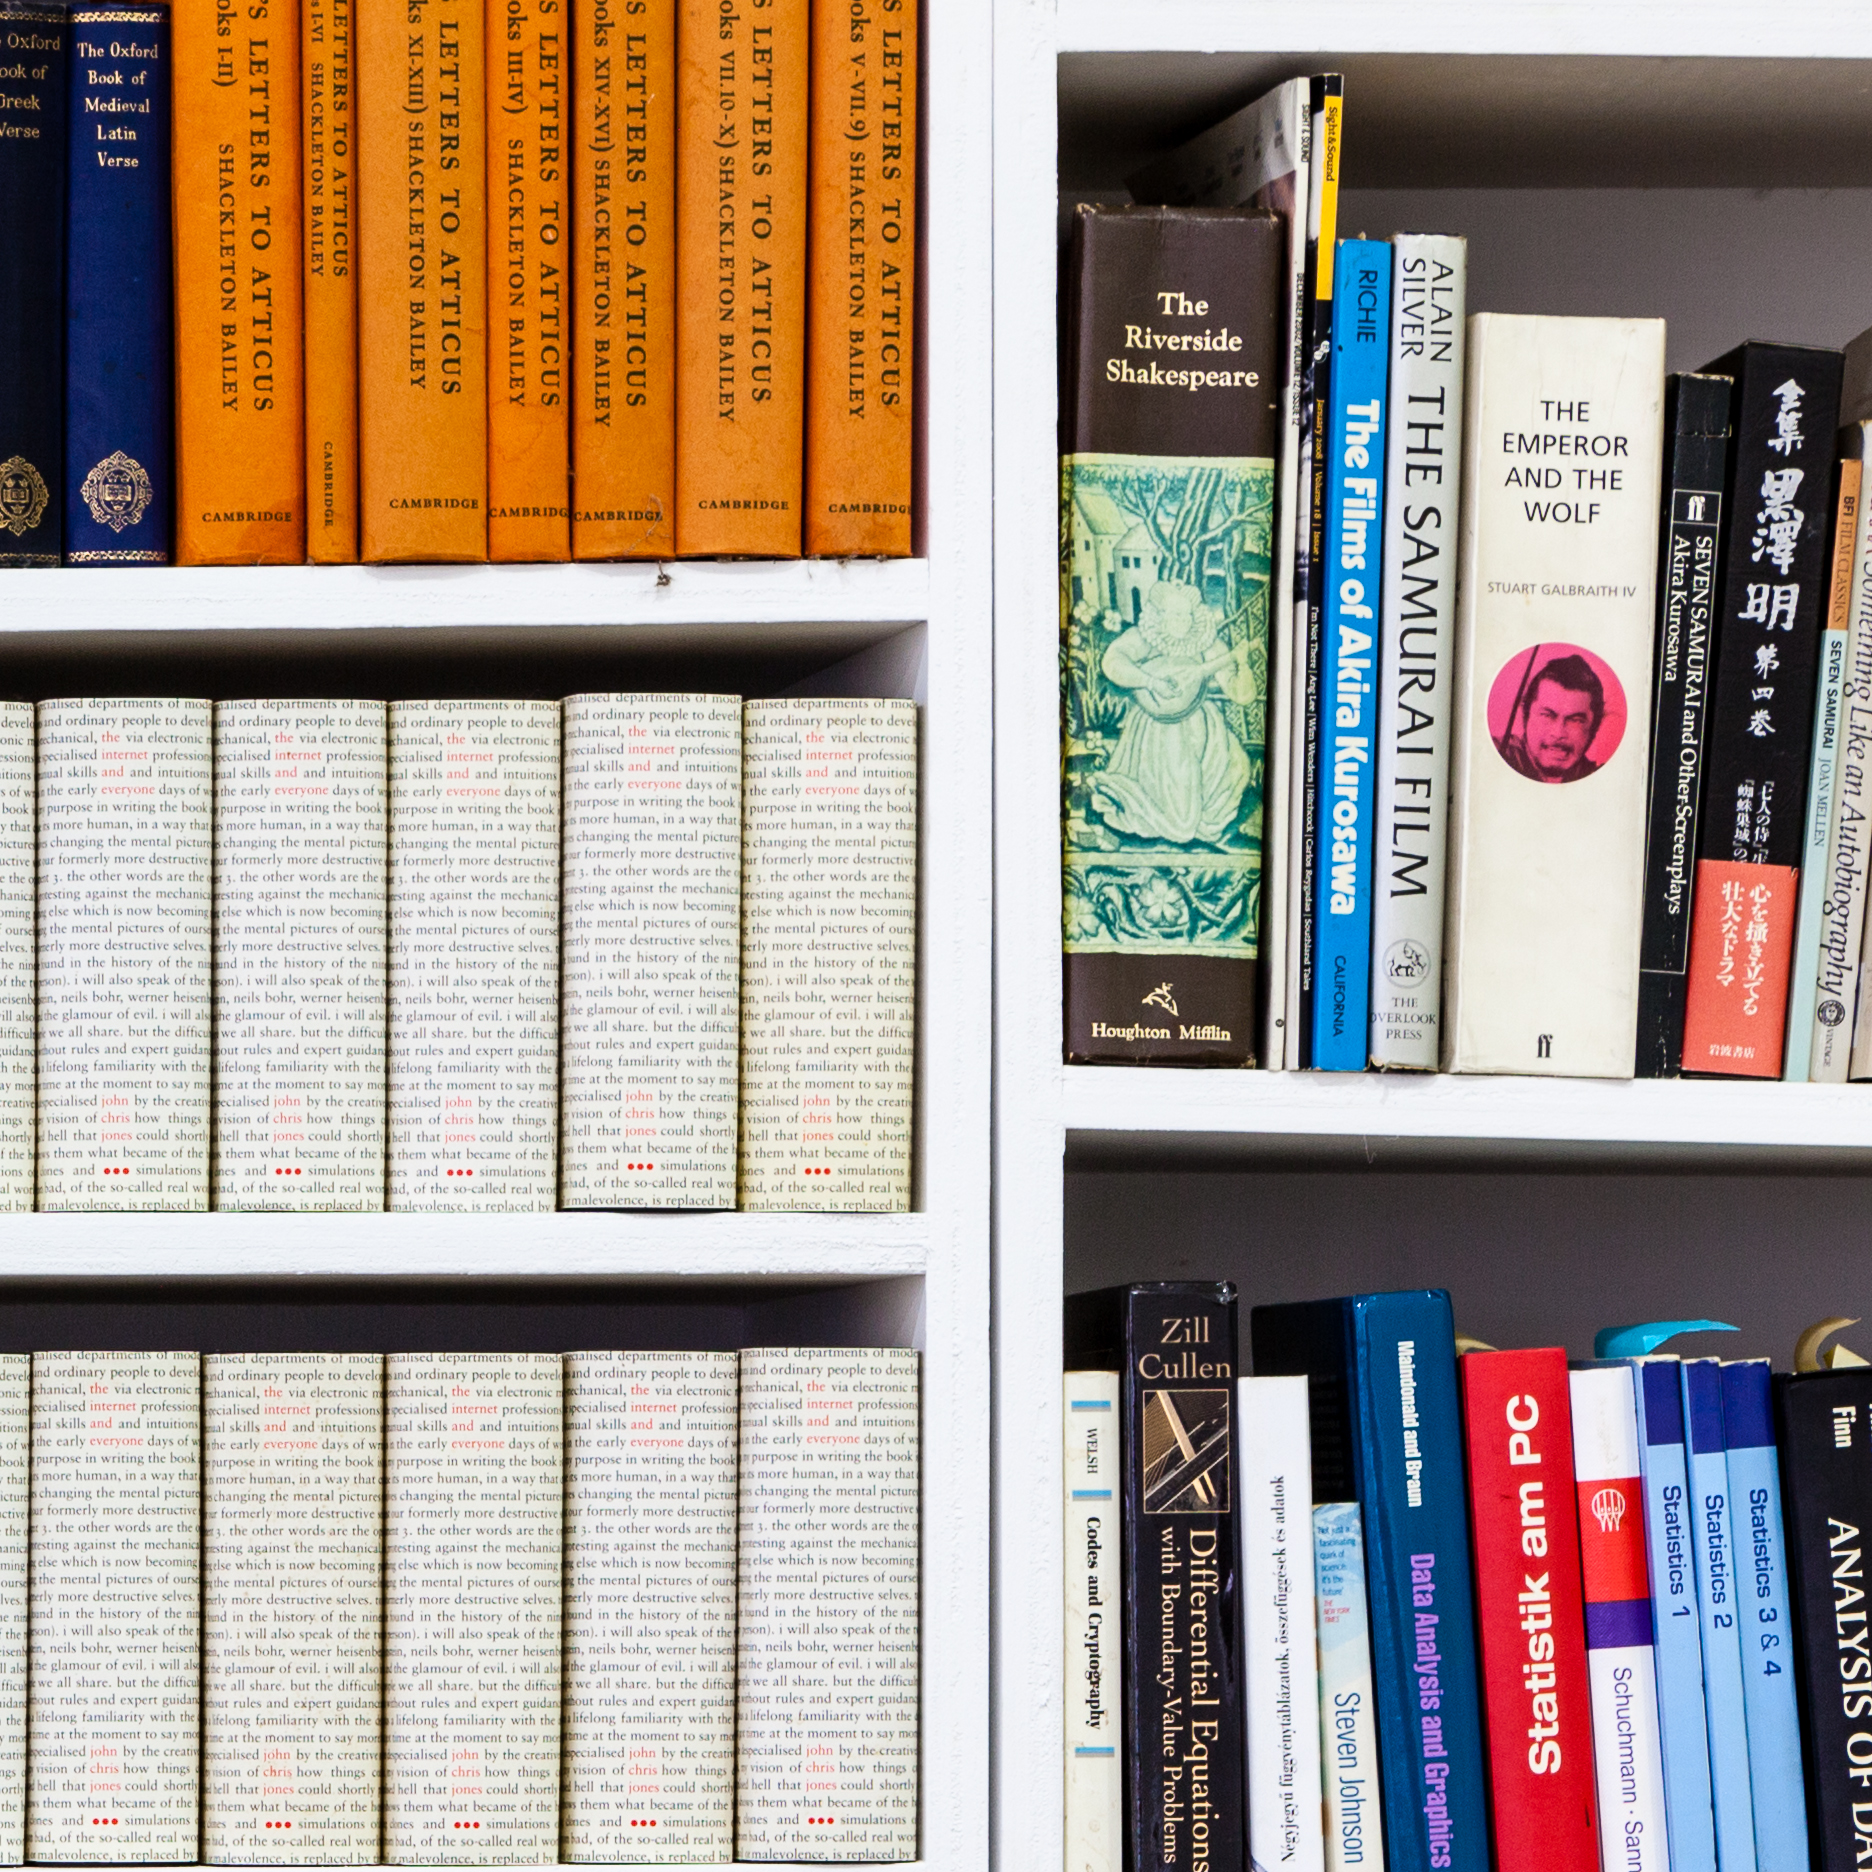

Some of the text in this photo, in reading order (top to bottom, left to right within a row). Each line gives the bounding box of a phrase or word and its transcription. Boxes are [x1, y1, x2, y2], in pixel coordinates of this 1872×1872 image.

[219, 144, 237, 411] SHACKLETON BAILEY
[1157, 292, 1208, 316] The
[1357, 270, 1378, 343] RICHIE
[1125, 325, 1242, 351] Riverside
[1107, 359, 1259, 391] Shakespeare
[1504, 433, 1628, 456] EMPEROR
[1524, 502, 1599, 523] WOLF
[1488, 582, 1636, 597] STUART GALBRAITH IV
[1391, 386, 1445, 897] THE SAMURAI FILM
[1330, 399, 1380, 914] The Films of Akira Kurosawa
[826, 960, 869, 970] history
[1092, 1023, 1231, 1041] Houghton Mifflin
[800, 1060, 856, 1071] familiarity
[1161, 1317, 1209, 1343] Zill
[1139, 1352, 1230, 1379] Cullen
[1506, 1395, 1561, 1774] Statistik am PC
[1085, 1517, 1104, 1727] Codes and Cryptography
[1190, 1529, 1220, 1706] Differential
